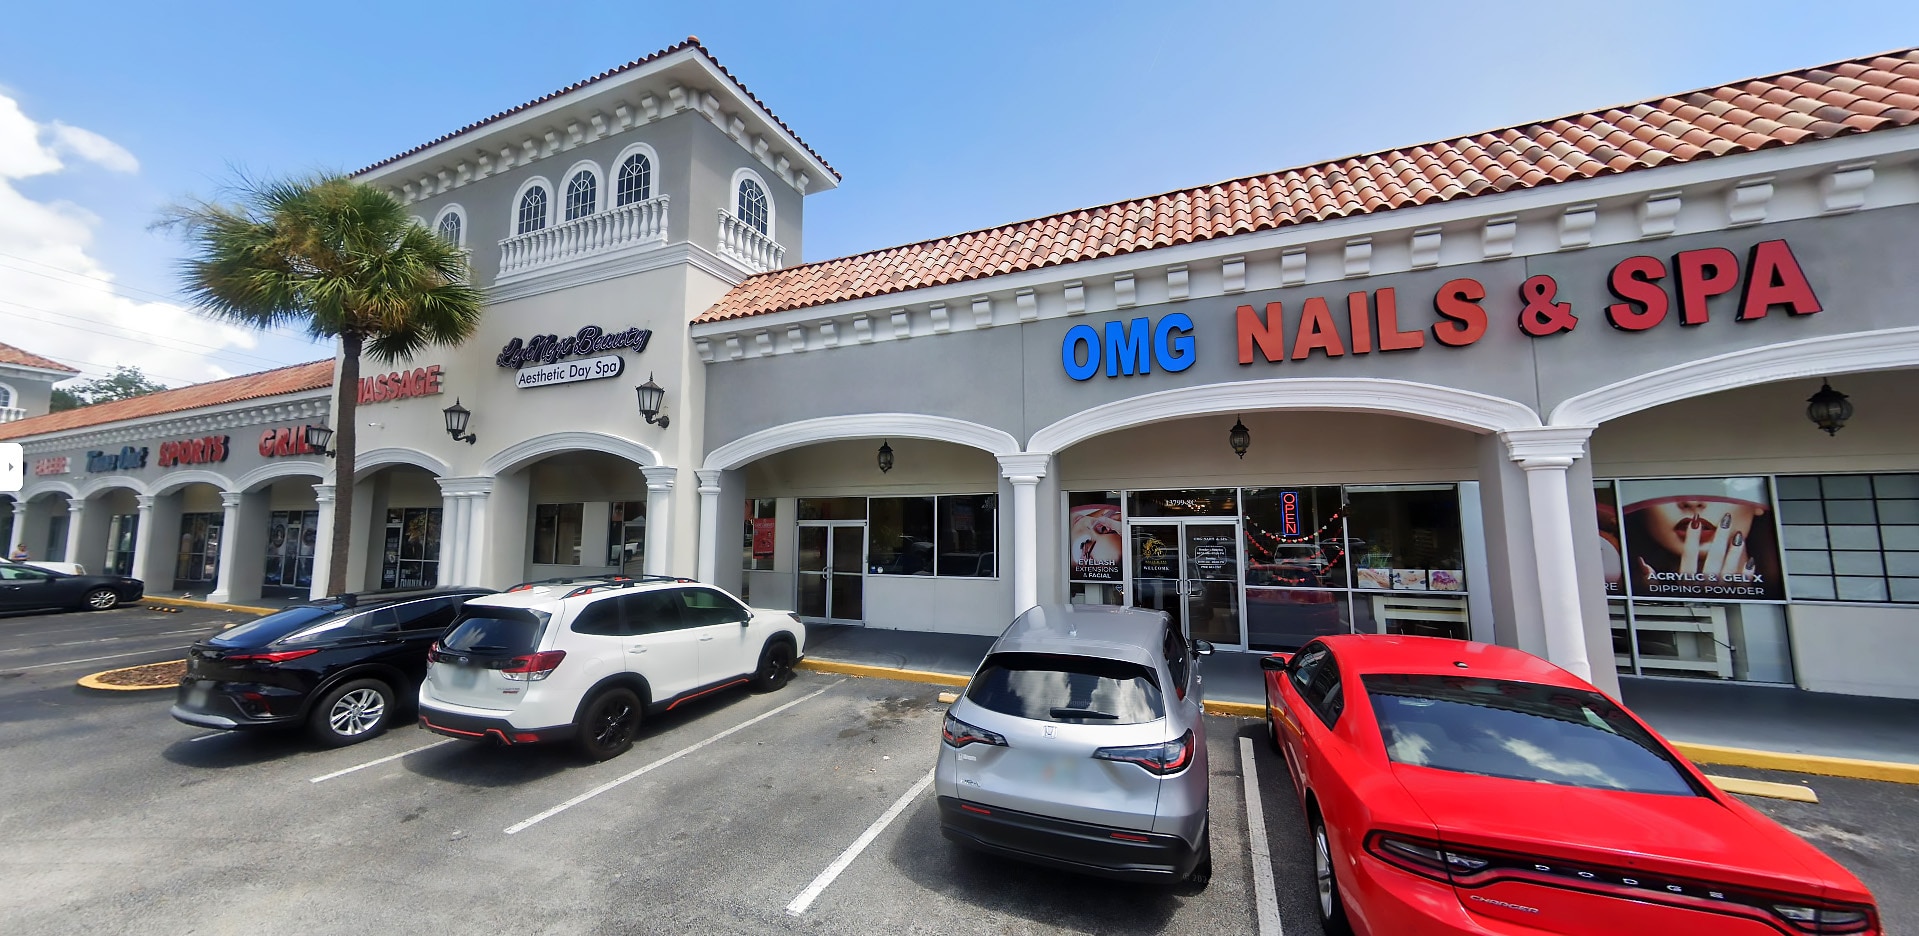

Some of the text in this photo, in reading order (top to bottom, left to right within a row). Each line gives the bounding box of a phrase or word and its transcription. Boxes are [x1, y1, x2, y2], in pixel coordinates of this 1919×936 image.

[1062, 238, 1823, 381] OMG NAILS & SPA
[573, 325, 652, 355] Beauty
[518, 360, 617, 385] Aesthetic Day Spa
[158, 434, 230, 467] SPORTS
[259, 423, 320, 457] GRIL
[1283, 493, 1297, 534] OPEN
[1647, 572, 1764, 583] ACRYLIC & GEL X
[1649, 584, 1765, 595] DIPPING POWDER
[1534, 864, 1725, 899] DODGE
[1469, 895, 1539, 914] CHARGER
